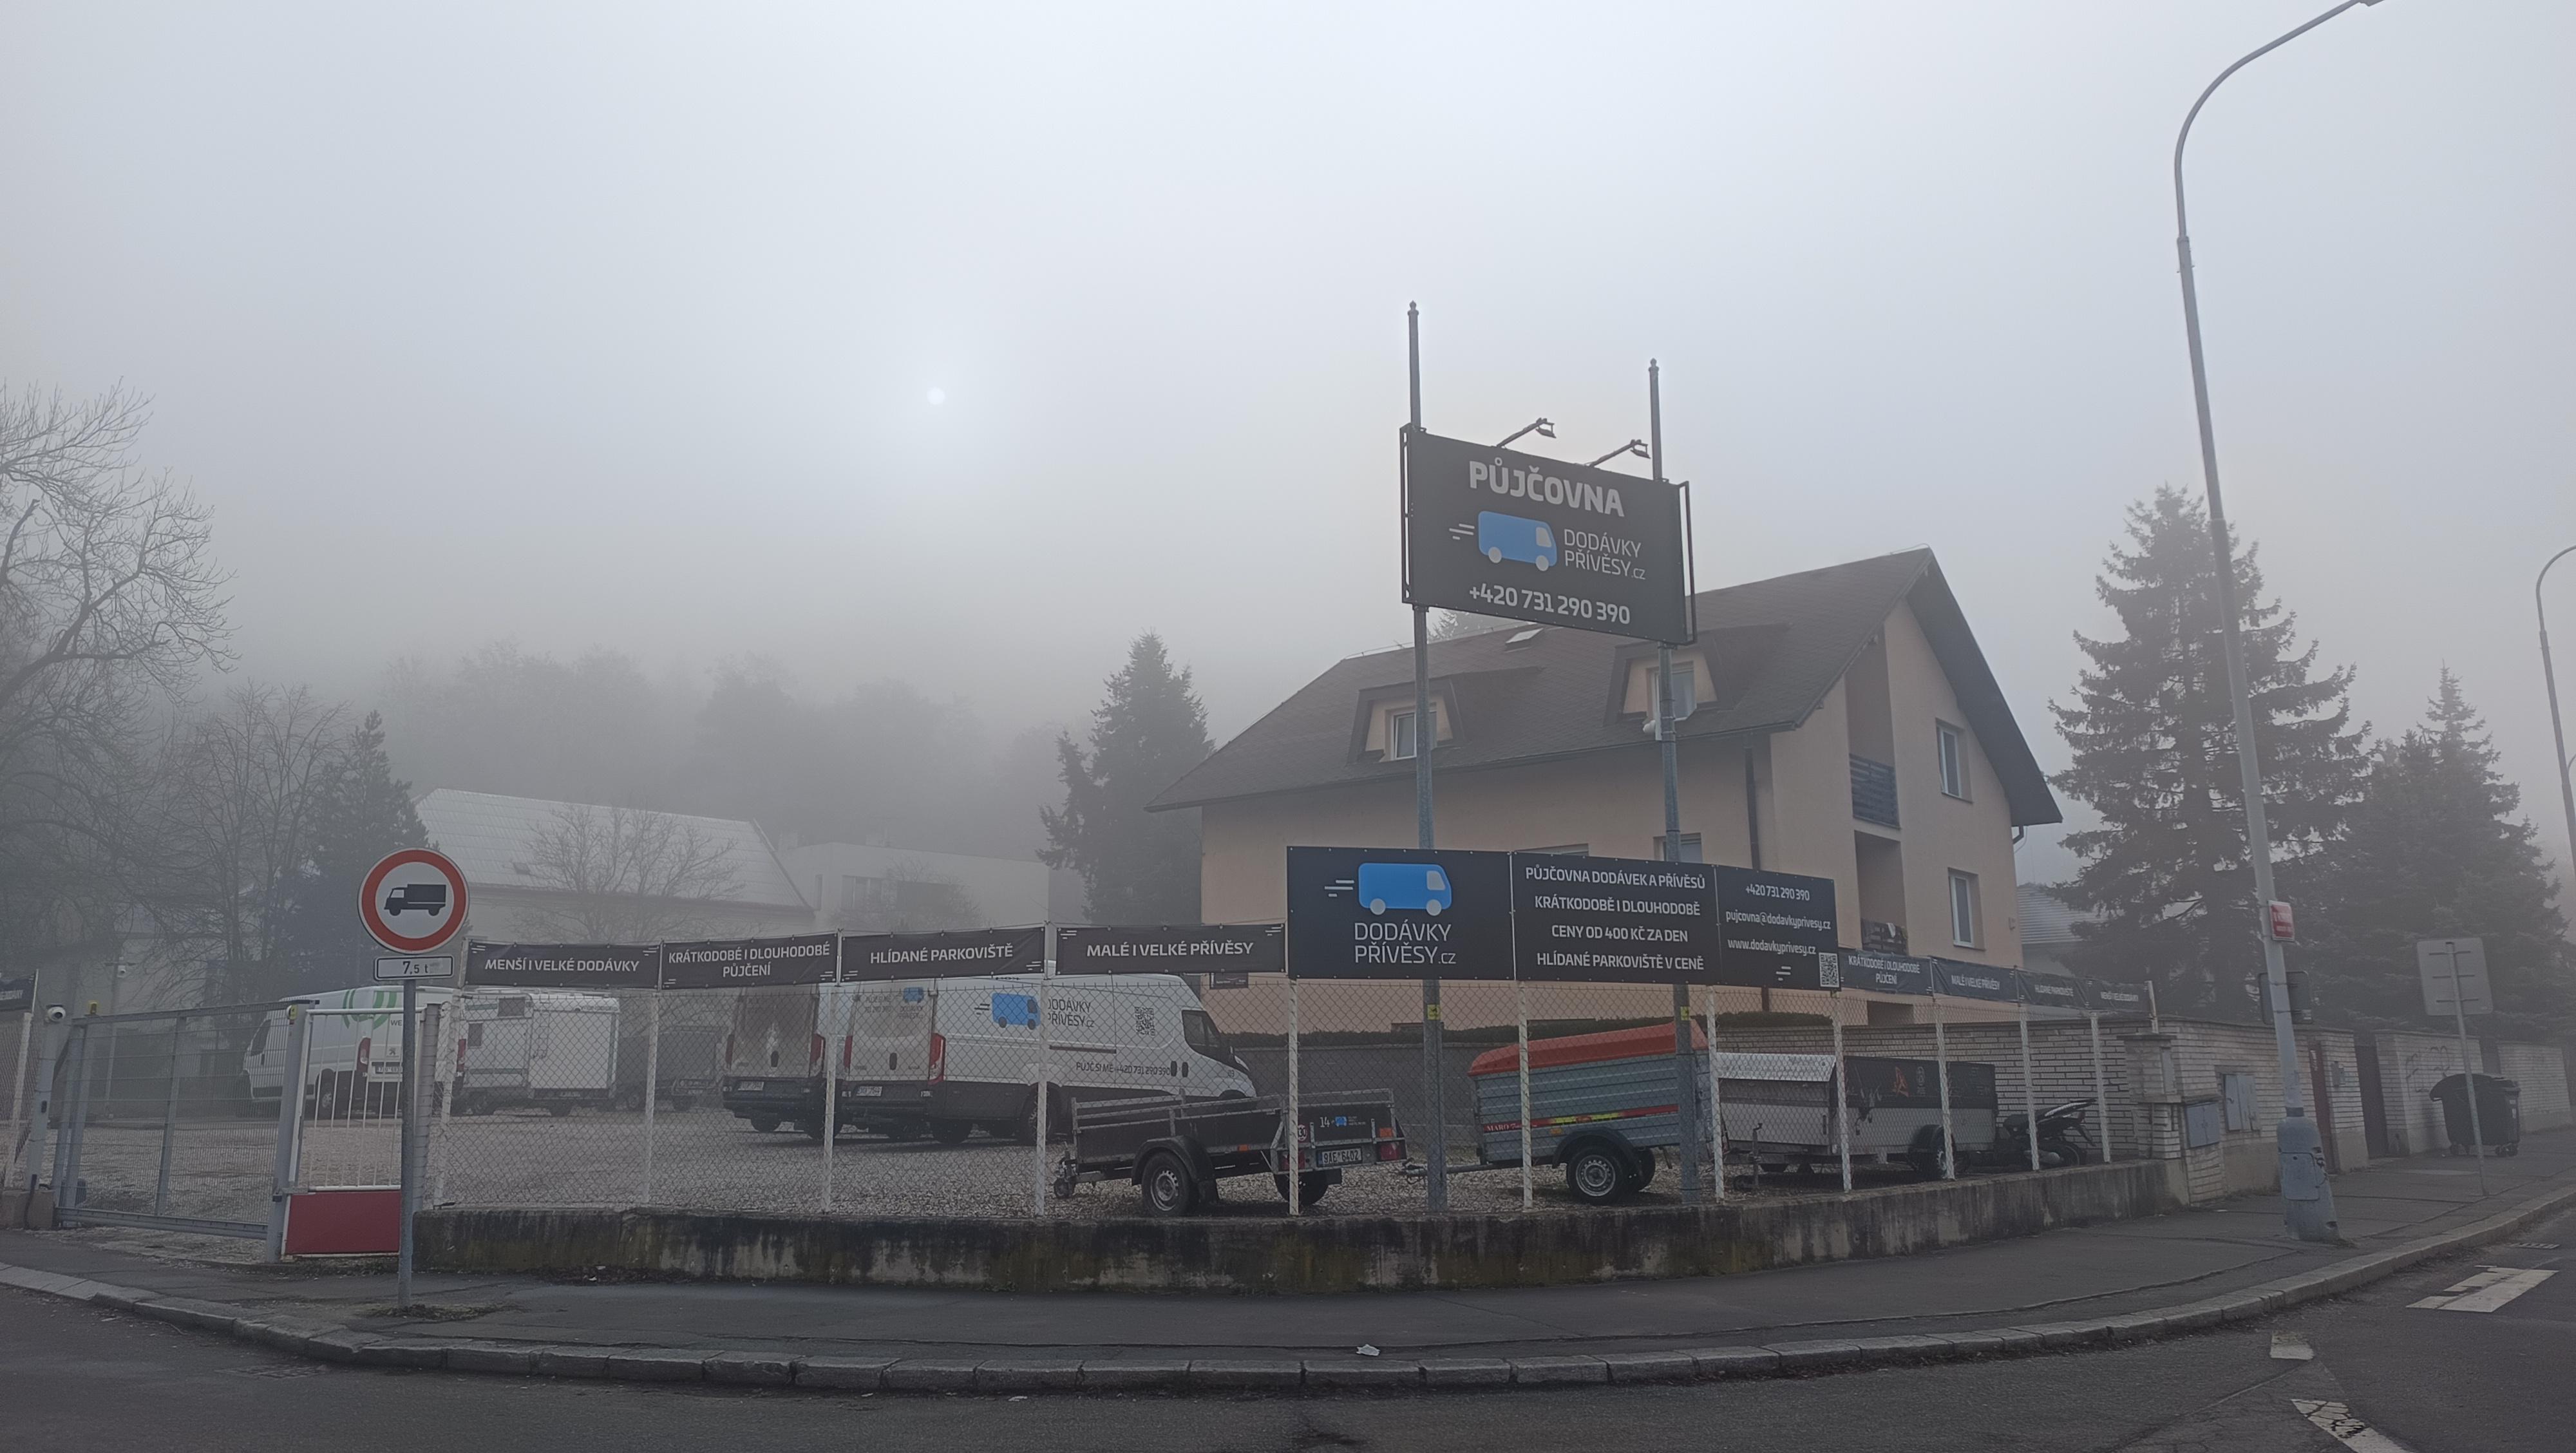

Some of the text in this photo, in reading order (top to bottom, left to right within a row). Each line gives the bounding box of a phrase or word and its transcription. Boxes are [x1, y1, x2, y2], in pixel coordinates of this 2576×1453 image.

[1469, 457, 1625, 517] PŮJČOVNA
[1564, 529, 1642, 558] DODÁVKY
[1469, 583, 1631, 625] +420 731 290 390
[1526, 864, 1705, 889] PŮJČOVNA DODÁVEK A PŘÍVĚSŮ
[1745, 884, 1810, 901] +420 731 290 390
[1535, 894, 1701, 916] KRÁTKODOBĚ I DLOUHODOBĚ
[1726, 909, 1832, 931] pujcovna@dodavkyprivesy.cz
[1354, 919, 1452, 942] DODÁVKY
[1551, 925, 1688, 942] CENY OD 400 KČ ZA DEN
[668, 941, 830, 964] KRÁTKODOBÉ I DLOUHODOBÉ
[870, 942, 1013, 964] HLÍDANÉ PARKOVIŠTĚ
[1086, 940, 1254, 956] MALÉ I VELKÉ PŘÍVĚSY
[1727, 938, 1817, 956] www.dodavkyprivesy.cz
[424, 965, 428, 974] t
[485, 957, 639, 972] MENŠÍ I VELKÉ DODÁVKY
[723, 962, 772, 978] PŮJČENÍ
[1537, 950, 1705, 970] HLÍDANÉ PARKOVIŠTĚ V CENĚ
[1320, 1116, 1330, 1128] 14
[1323, 1149, 1359, 1165] 9AE 6402
